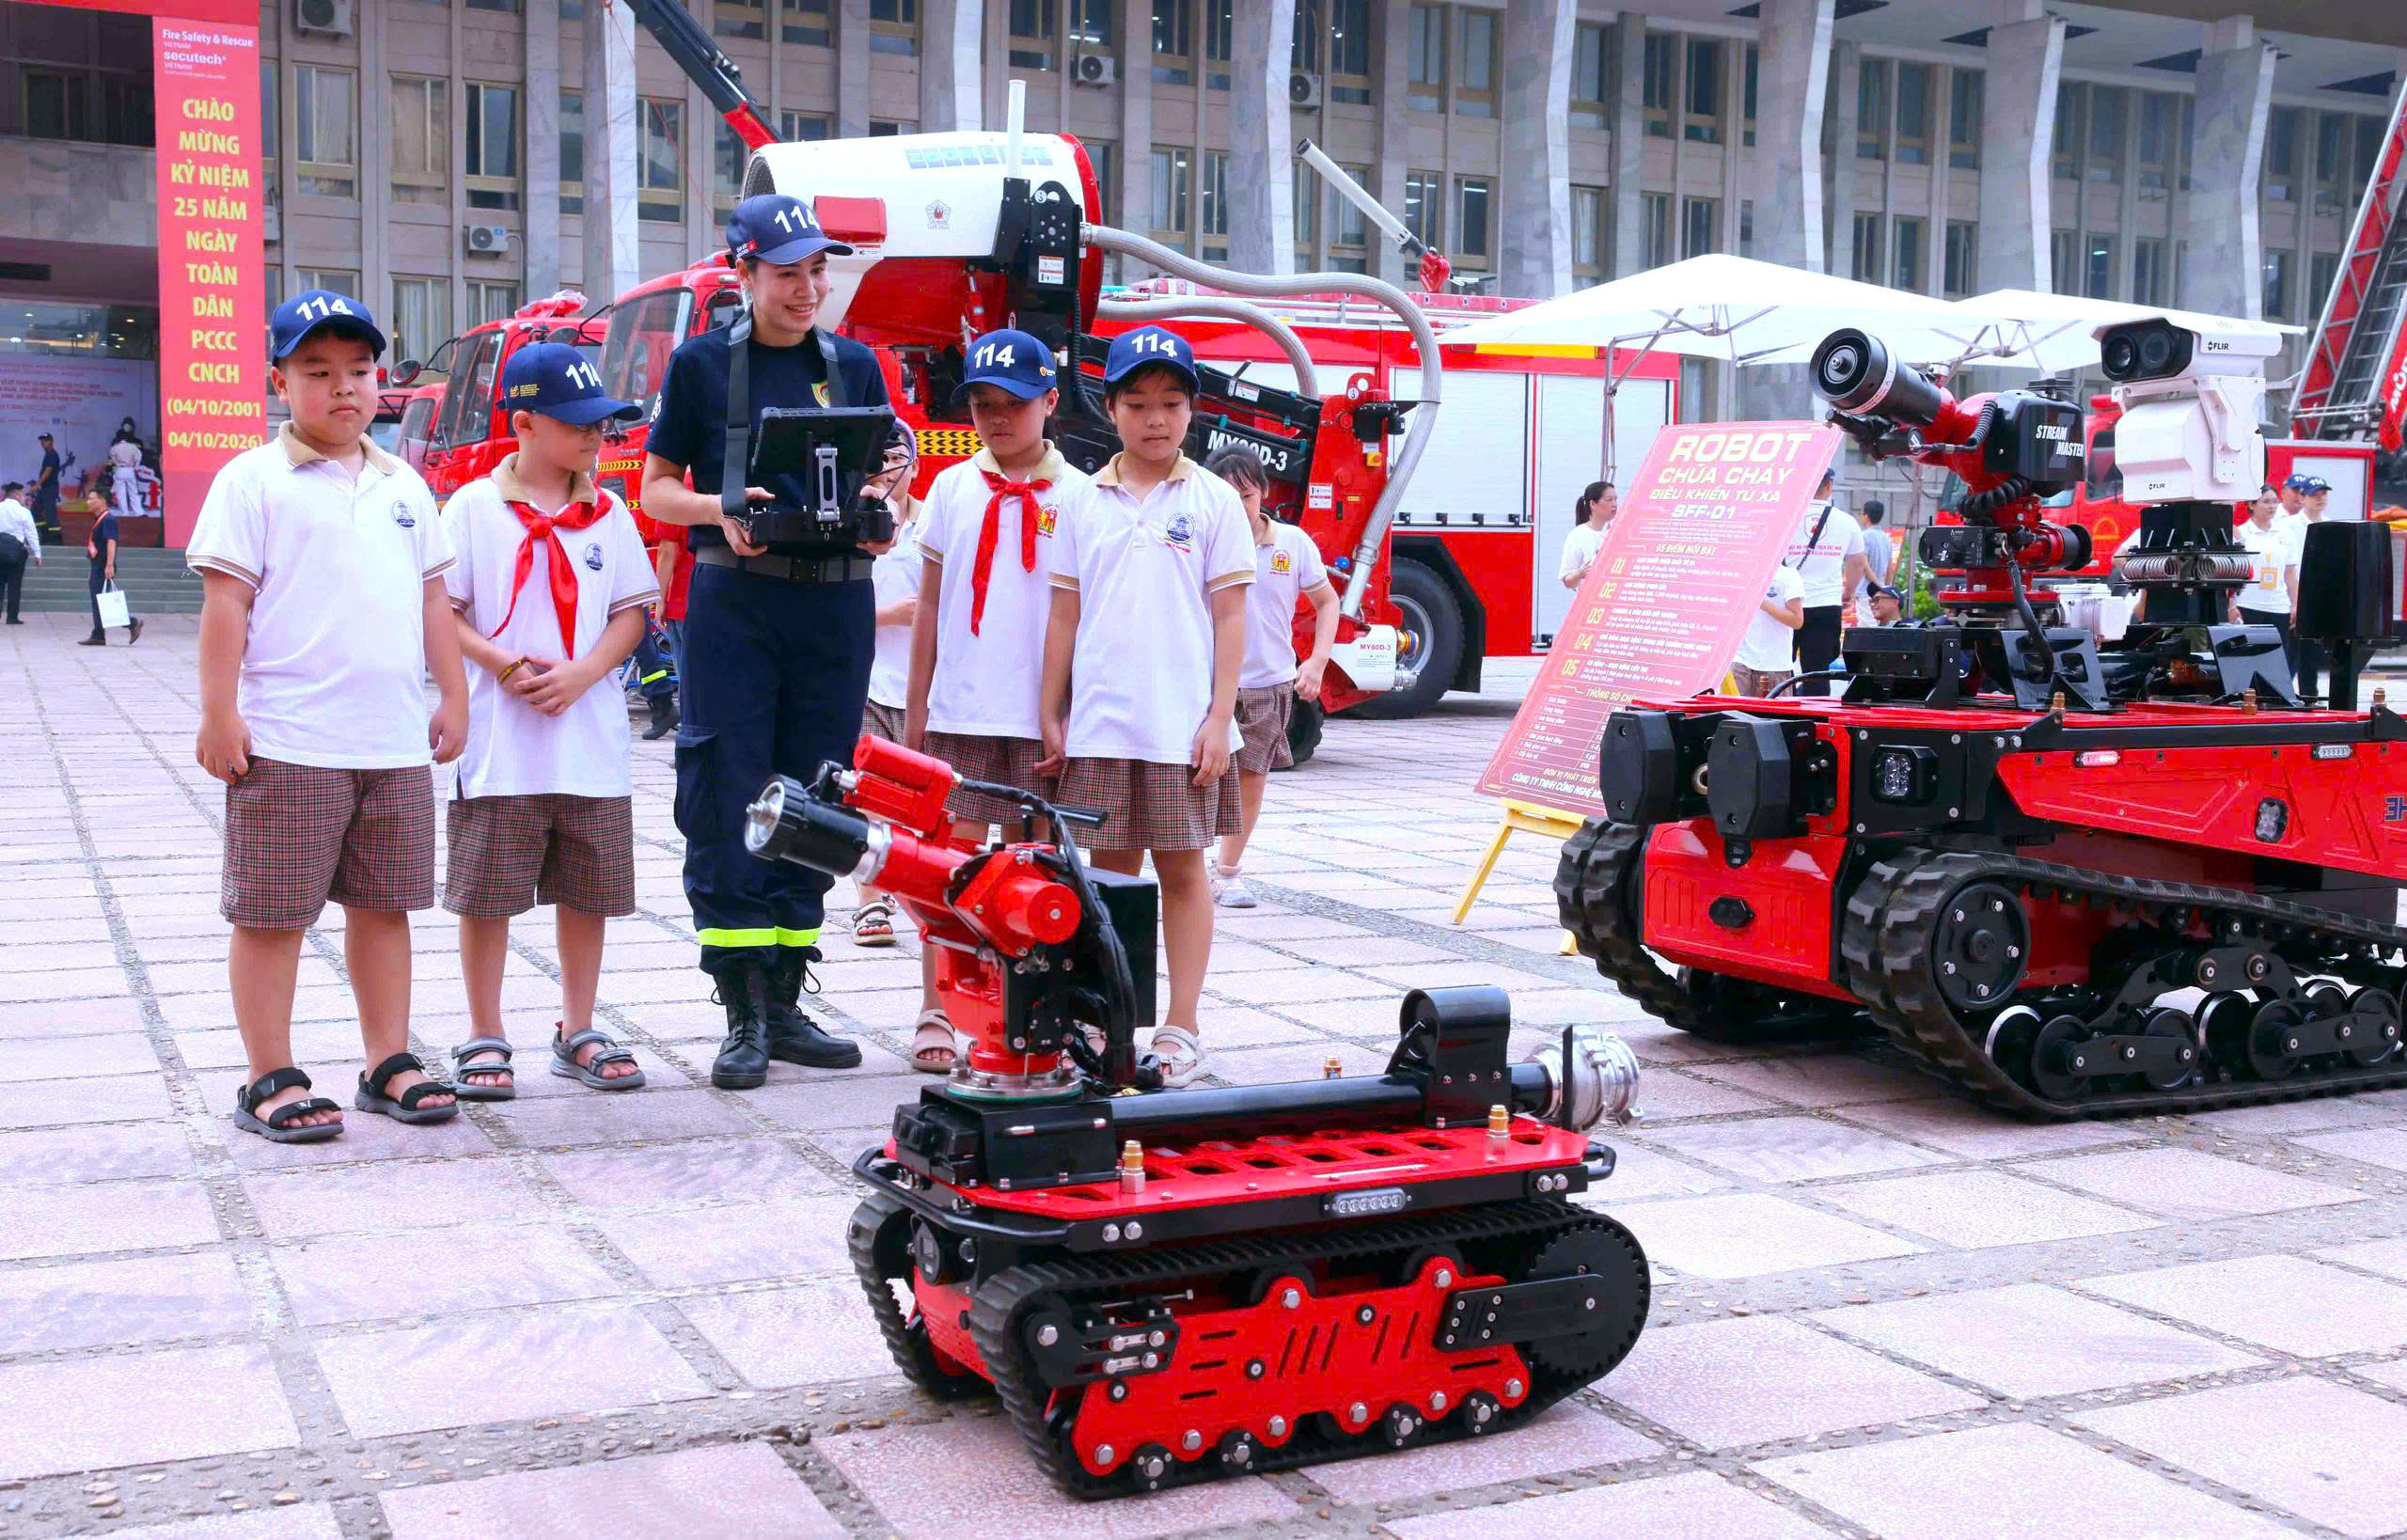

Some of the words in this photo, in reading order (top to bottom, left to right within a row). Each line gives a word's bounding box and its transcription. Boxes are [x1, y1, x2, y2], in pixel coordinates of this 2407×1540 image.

[163, 29, 181, 39] Fire
[181, 31, 212, 45] Safety
[212, 35, 220, 44] &
[222, 35, 254, 47] Rescue
[182, 98, 234, 121] CHÀO
[179, 129, 241, 155] MỪNG
[170, 159, 195, 183] KỶ
[199, 165, 249, 193] NIỆM
[174, 196, 197, 217] 25
[203, 196, 248, 221] NĂM
[775, 205, 820, 233] 114
[186, 228, 238, 253] NGÀY
[186, 261, 238, 286] TOÀN
[193, 294, 233, 318] DÂN
[295, 295, 354, 322] 114
[191, 329, 237, 351] PCCC
[1131, 333, 1177, 358] 114
[974, 342, 1015, 369] 114
[188, 363, 240, 385] CNCH
[166, 398, 261, 418] (04/10/2001
[167, 432, 263, 450] 04/10/2026)
[2036, 425, 2068, 441] STREAM
[1669, 432, 1814, 463] ROBOT
[2055, 441, 2084, 457] MASTER
[1724, 462, 1794, 485] CHÁY
[1758, 490, 1781, 503] XA
[1672, 504, 1738, 520] SFF-01
[1610, 557, 1625, 574] 01
[1598, 581, 1617, 599] 02
[1587, 607, 1604, 624] 03
[1574, 634, 1595, 651] 04
[1561, 659, 1581, 677] 05
[1587, 686, 1610, 699] THÔNG
[1512, 773, 1532, 785] CÔNG
[1531, 776, 1540, 786] TY
[1538, 778, 1557, 790] TNHH
[1556, 780, 1575, 794] CÔNG
[1574, 785, 1593, 798] NGHỆ
